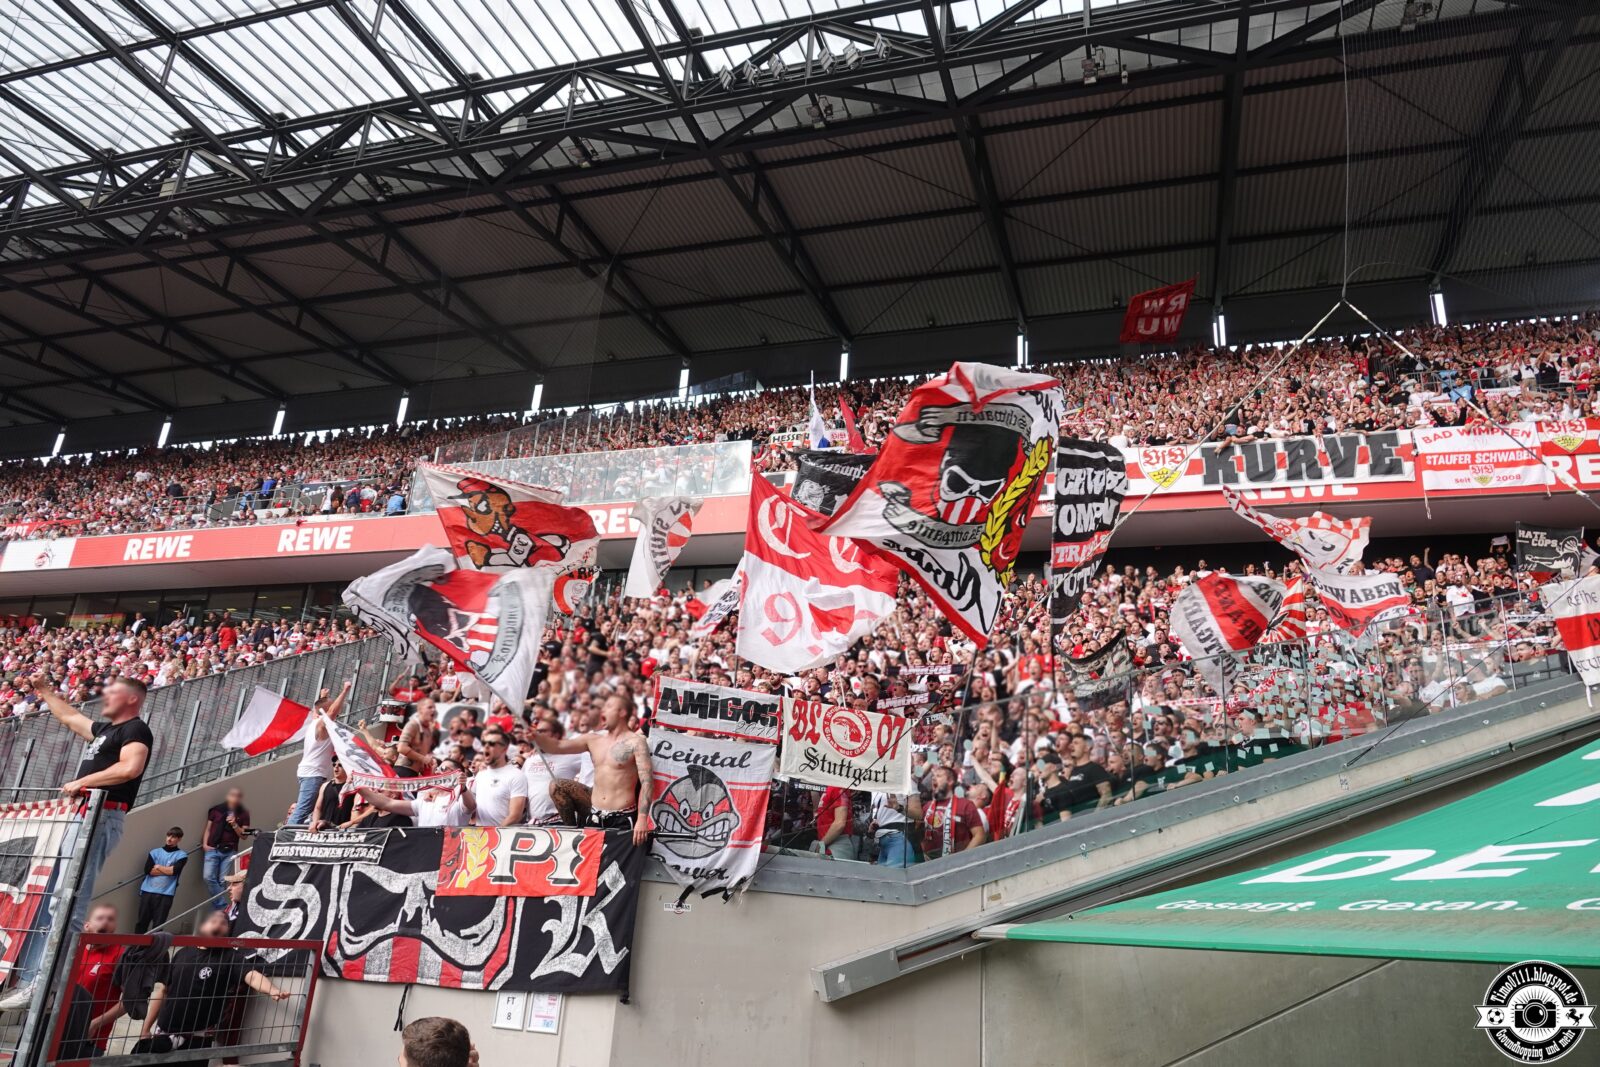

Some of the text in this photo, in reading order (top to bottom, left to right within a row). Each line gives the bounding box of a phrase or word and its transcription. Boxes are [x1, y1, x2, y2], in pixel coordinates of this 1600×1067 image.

[1422, 425, 1532, 444] BAD WIMPFEN
[1202, 432, 1404, 486] KURVE
[1426, 449, 1537, 466] STAUFER SCHWABEN
[1496, 474, 1521, 482] 2008
[277, 526, 353, 552] REWE
[1518, 530, 1547, 540] HATE
[1531, 538, 1558, 548] COPS
[123, 535, 194, 560] REWE
[877, 714, 906, 761] 07
[653, 740, 752, 769] Leintal
[799, 747, 888, 787] Stuttgart
[1240, 838, 1600, 885] DE
[1338, 899, 1529, 911] Getan.
[506, 996, 516, 1005] FT
[506, 1012, 512, 1020] 8
